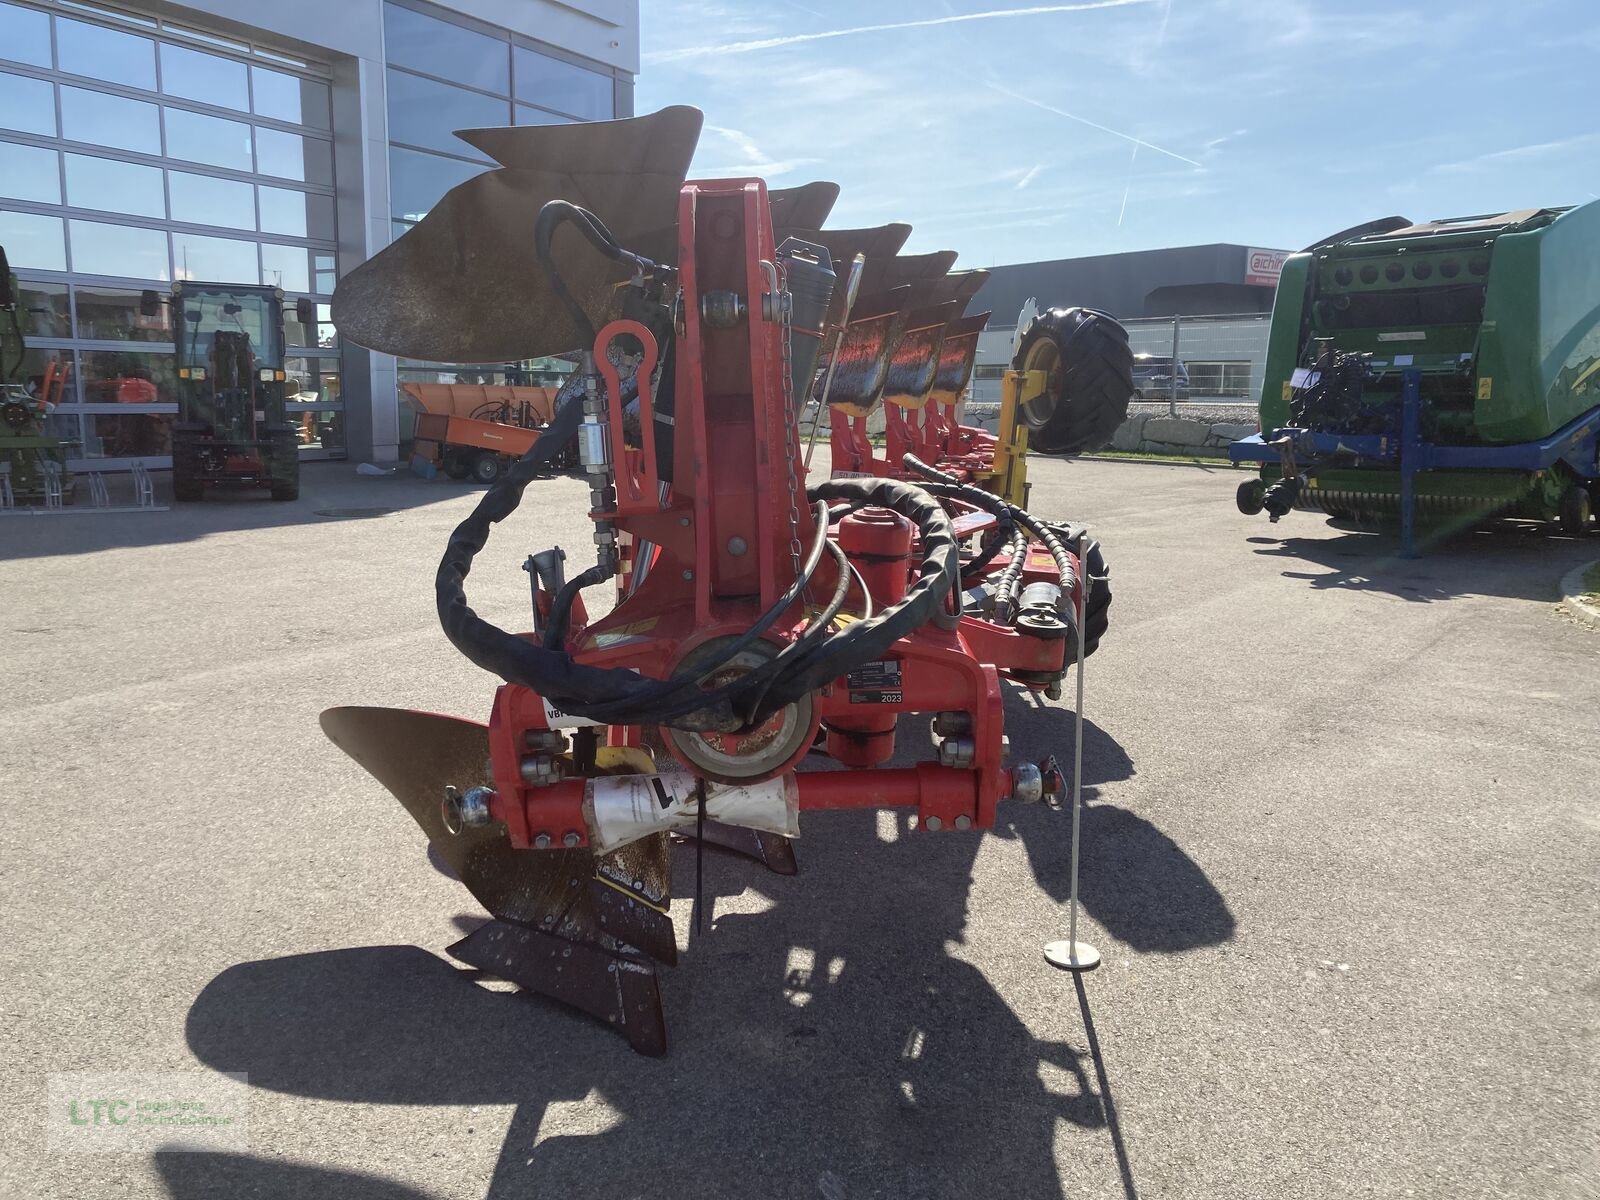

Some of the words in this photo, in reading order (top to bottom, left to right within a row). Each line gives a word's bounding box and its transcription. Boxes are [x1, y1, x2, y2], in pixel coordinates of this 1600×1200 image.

[1253, 255, 1283, 270] aichin
[881, 694, 902, 703] 2023
[651, 777, 674, 810] 1
